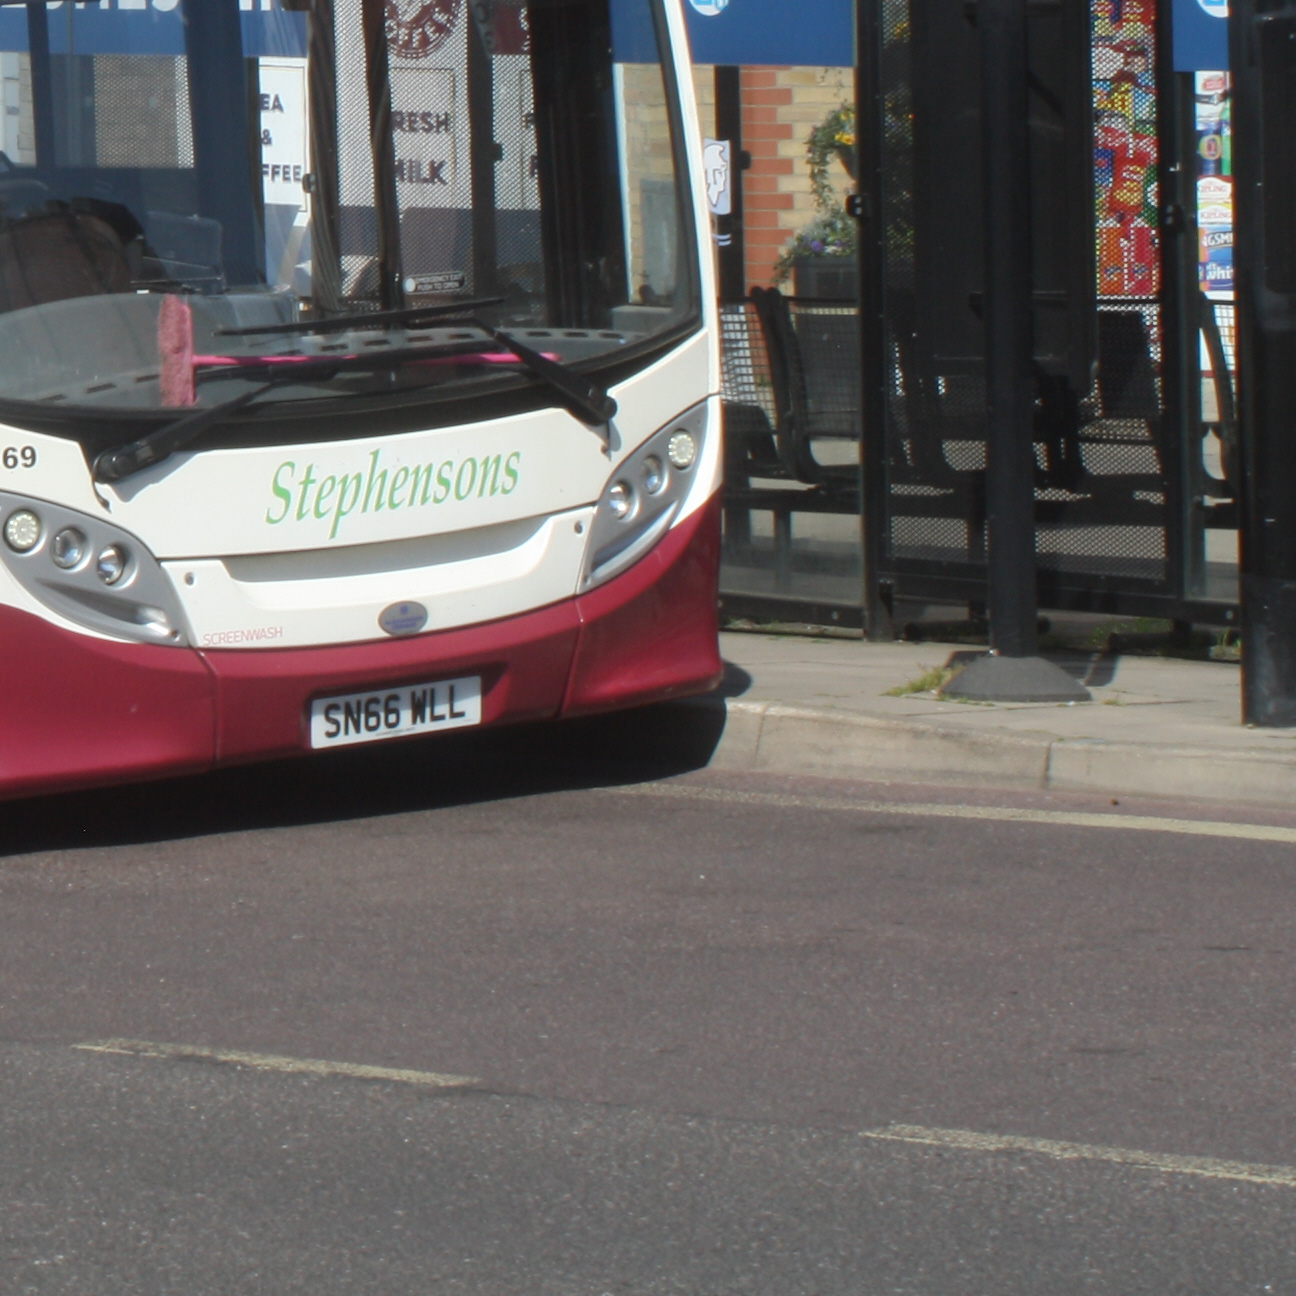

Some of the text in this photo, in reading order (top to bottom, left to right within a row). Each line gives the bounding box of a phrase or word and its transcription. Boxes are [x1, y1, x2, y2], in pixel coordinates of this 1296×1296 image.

[260, 93, 284, 112] EA
[392, 110, 449, 134] RESH
[266, 448, 522, 540] Stephensons
[202, 626, 284, 647] SCREENWASH
[323, 684, 467, 739] SN66 WLL
